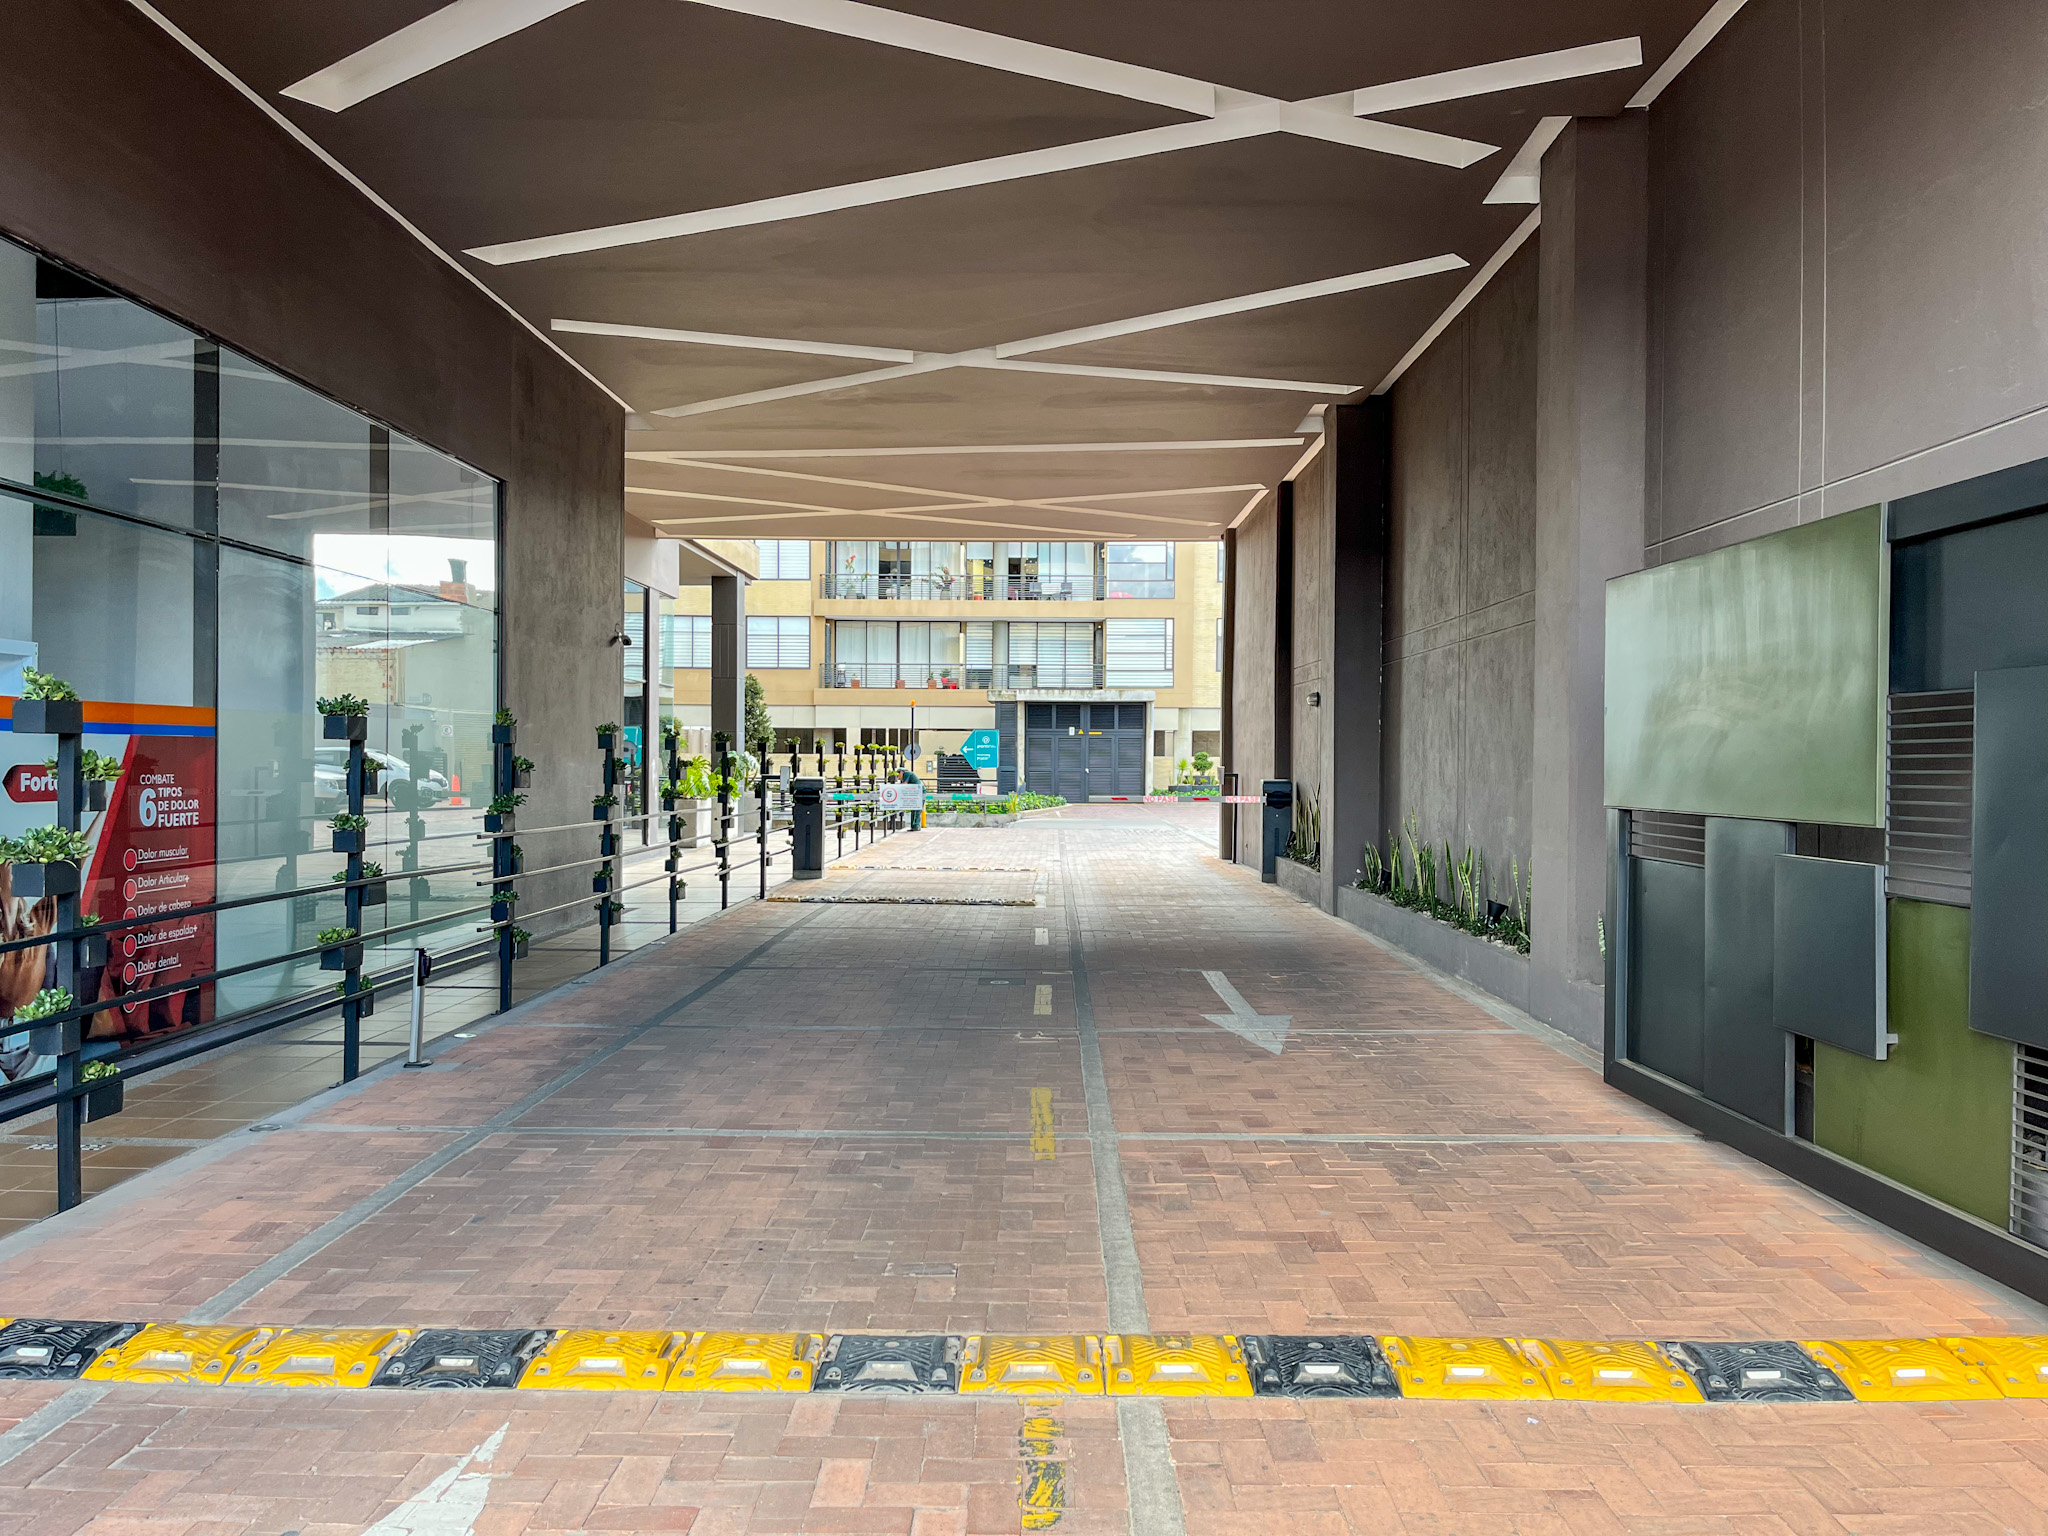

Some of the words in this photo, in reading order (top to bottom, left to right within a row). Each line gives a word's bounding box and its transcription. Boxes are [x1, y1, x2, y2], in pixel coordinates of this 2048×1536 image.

[140, 774, 175, 785] COMBATE
[886, 790, 893, 798] 5
[1144, 795, 1155, 803] NO
[1157, 795, 1178, 803] PASE
[139, 787, 157, 827] 6
[158, 787, 183, 798] TIPOS
[158, 800, 170, 811] DE
[170, 799, 200, 811] DOLOR
[158, 811, 200, 828] FUERTE
[138, 847, 158, 860] Dolor
[158, 844, 189, 858] muscular
[138, 875, 158, 888] Dolor
[138, 903, 157, 917] Dolor
[158, 901, 168, 913] de
[168, 898, 192, 911] cabeza
[137, 930, 157, 945] Dolor
[158, 928, 167, 940] de
[137, 959, 157, 973] Dolor
[158, 952, 179, 968] dental
